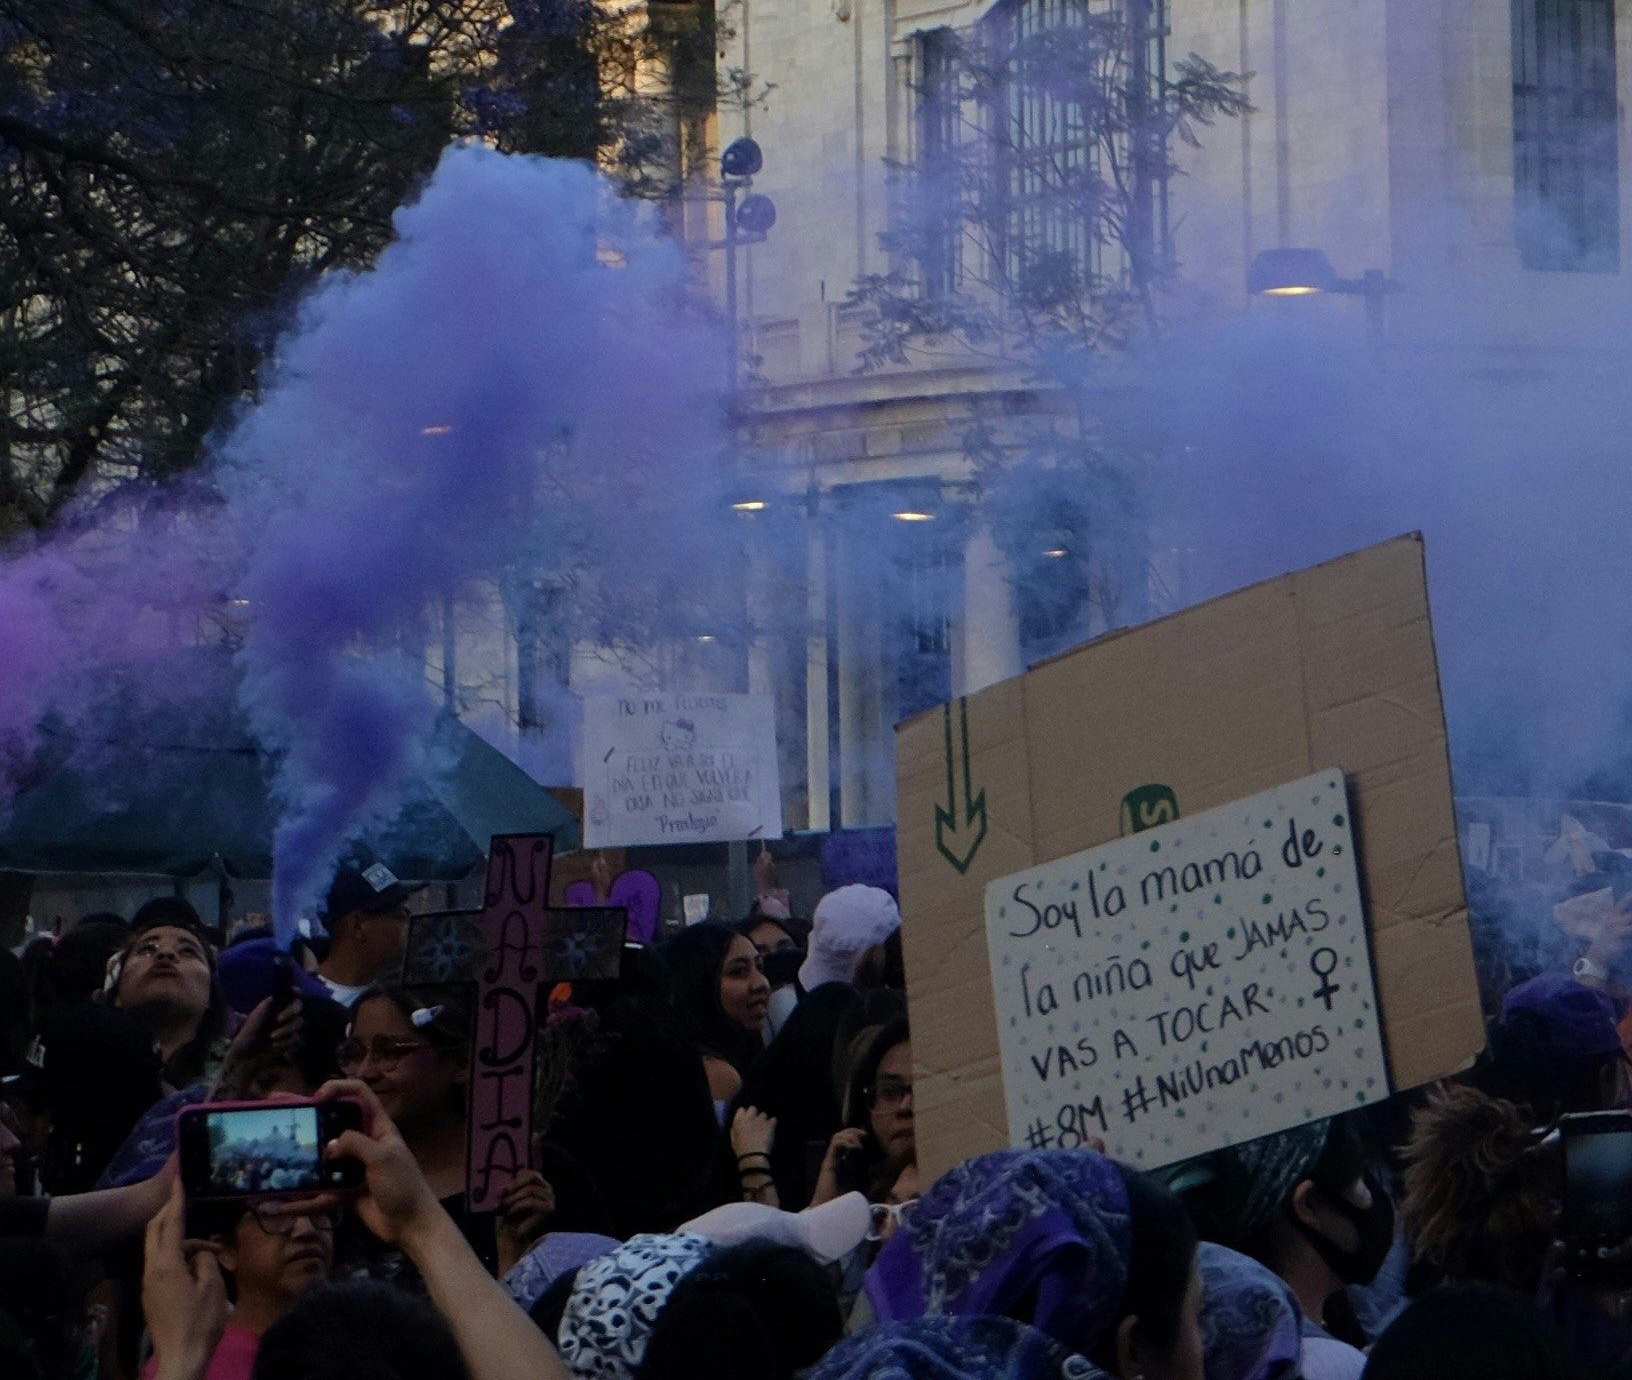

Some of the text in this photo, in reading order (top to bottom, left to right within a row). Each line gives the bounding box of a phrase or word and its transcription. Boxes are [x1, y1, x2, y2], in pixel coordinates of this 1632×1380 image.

[1009, 817, 1323, 937] Soy la mamá de
[1021, 898, 1330, 1017] la niña que JAMAS
[472, 840, 545, 1204] NADIA
[1031, 982, 1270, 1082] VAS A TOCAR
[1025, 1024, 1329, 1150] #8M #NiUnaMenos
